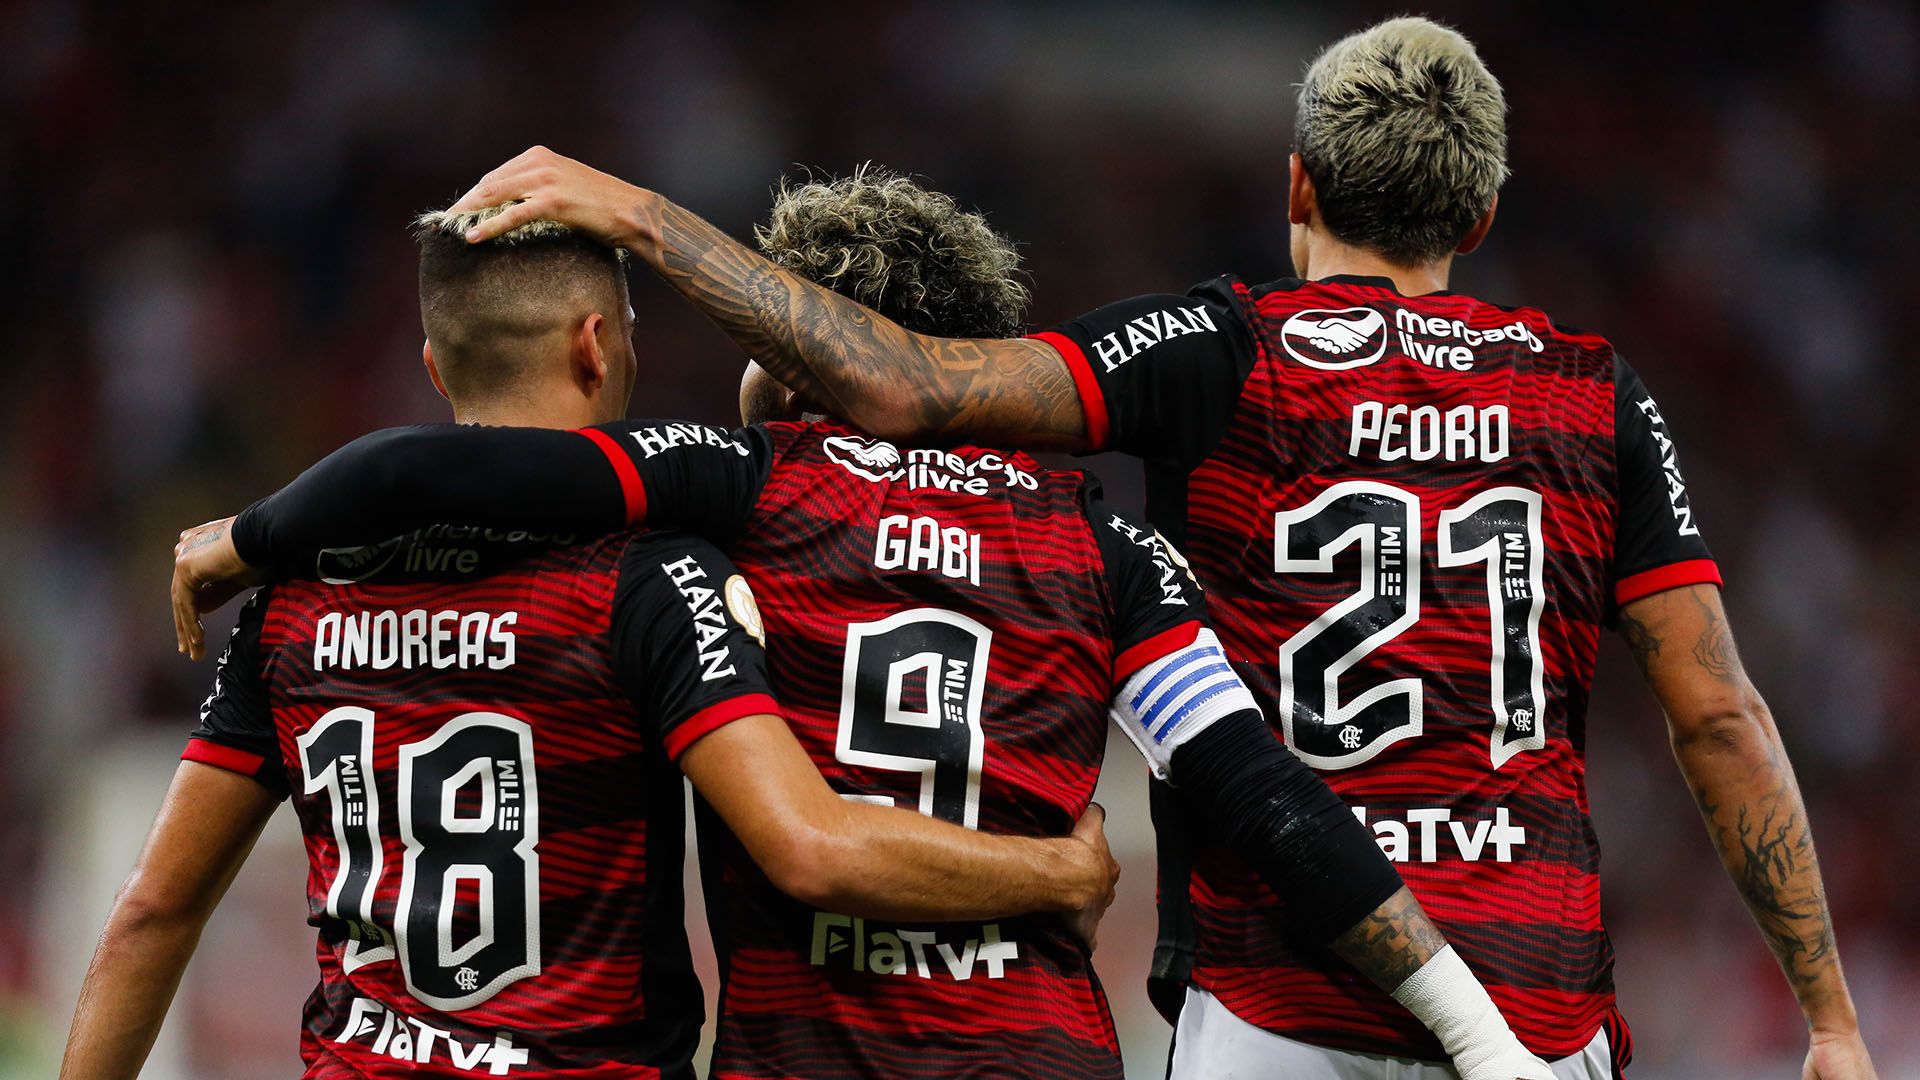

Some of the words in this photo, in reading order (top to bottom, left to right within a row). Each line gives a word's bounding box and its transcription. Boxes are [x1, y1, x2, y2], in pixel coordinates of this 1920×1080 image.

[1091, 304, 1217, 373] HAVAN
[1396, 308, 1545, 353] mercado
[1398, 330, 1475, 371] livre
[1348, 400, 1510, 463] PEDRO
[909, 463, 989, 496] livre
[1636, 395, 1701, 537] HAVAN
[404, 542, 480, 573] livre
[874, 514, 981, 587] GABI
[1107, 514, 1189, 606] HAVAN
[1380, 526, 1401, 569] TIM
[1502, 532, 1525, 574] TIM
[313, 609, 518, 672] ANDREAS
[661, 554, 737, 682] HAVAN
[1274, 480, 1546, 771] 21
[943, 658, 968, 701] TIM
[835, 607, 993, 831] 9
[339, 754, 362, 799] TIM
[496, 759, 520, 803] TIM
[296, 705, 541, 1011] 18
[1351, 806, 1526, 863] aTv+
[810, 911, 1019, 981] FlaTv+
[334, 997, 529, 1076] FlaTv+
